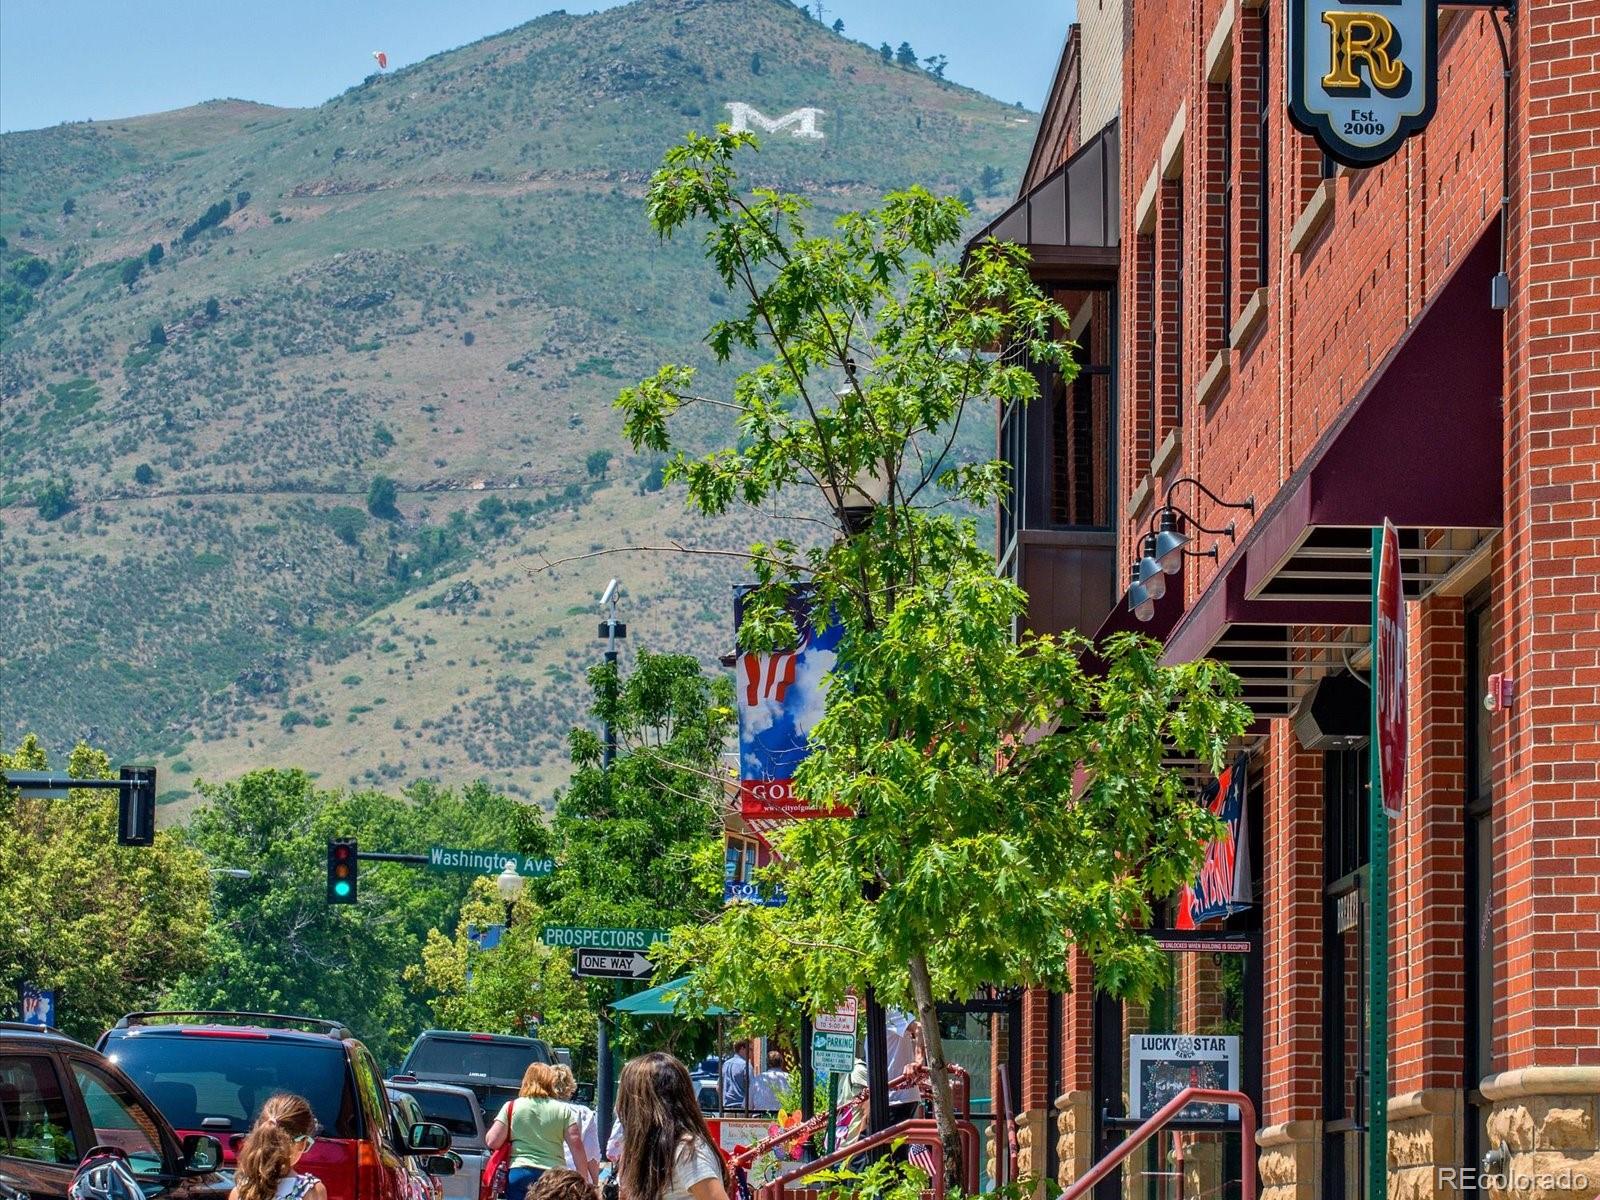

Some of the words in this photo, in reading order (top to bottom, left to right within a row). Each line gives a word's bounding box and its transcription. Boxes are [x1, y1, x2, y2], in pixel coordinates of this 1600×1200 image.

[1322, 11, 1405, 92] R
[724, 102, 826, 138] M
[1351, 109, 1378, 122] Est.
[1343, 122, 1385, 135] 2009
[1379, 610, 1404, 724] STOP
[523, 857, 553, 873] Ave
[546, 928, 645, 947] PROSPECTORS
[584, 957, 606, 968] ONE
[610, 958, 634, 969] WAY
[827, 1037, 852, 1048] PARKING
[1141, 1038, 1177, 1051] LUCKY
[1193, 1038, 1226, 1051] STAR
